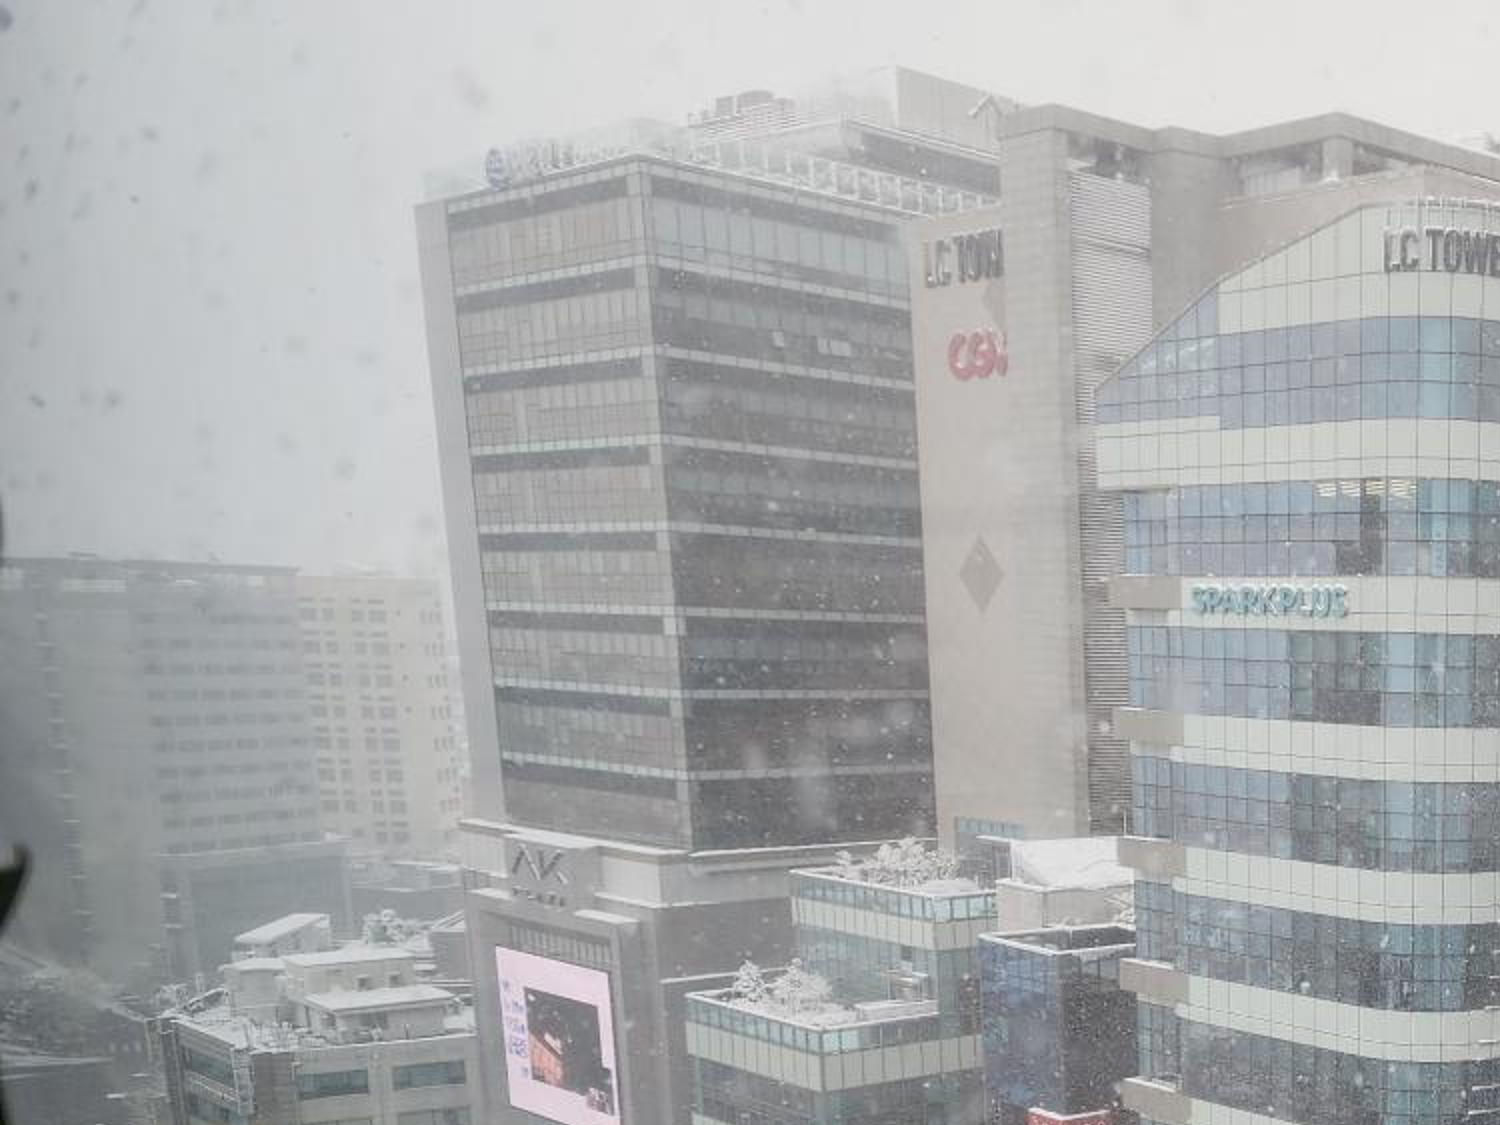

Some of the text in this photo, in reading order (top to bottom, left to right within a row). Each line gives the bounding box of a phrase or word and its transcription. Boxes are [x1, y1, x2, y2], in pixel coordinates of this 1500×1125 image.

[1383, 228, 1419, 272] LC
[1192, 583, 1349, 618] SPARKPLUS
[512, 842, 569, 885] AK
